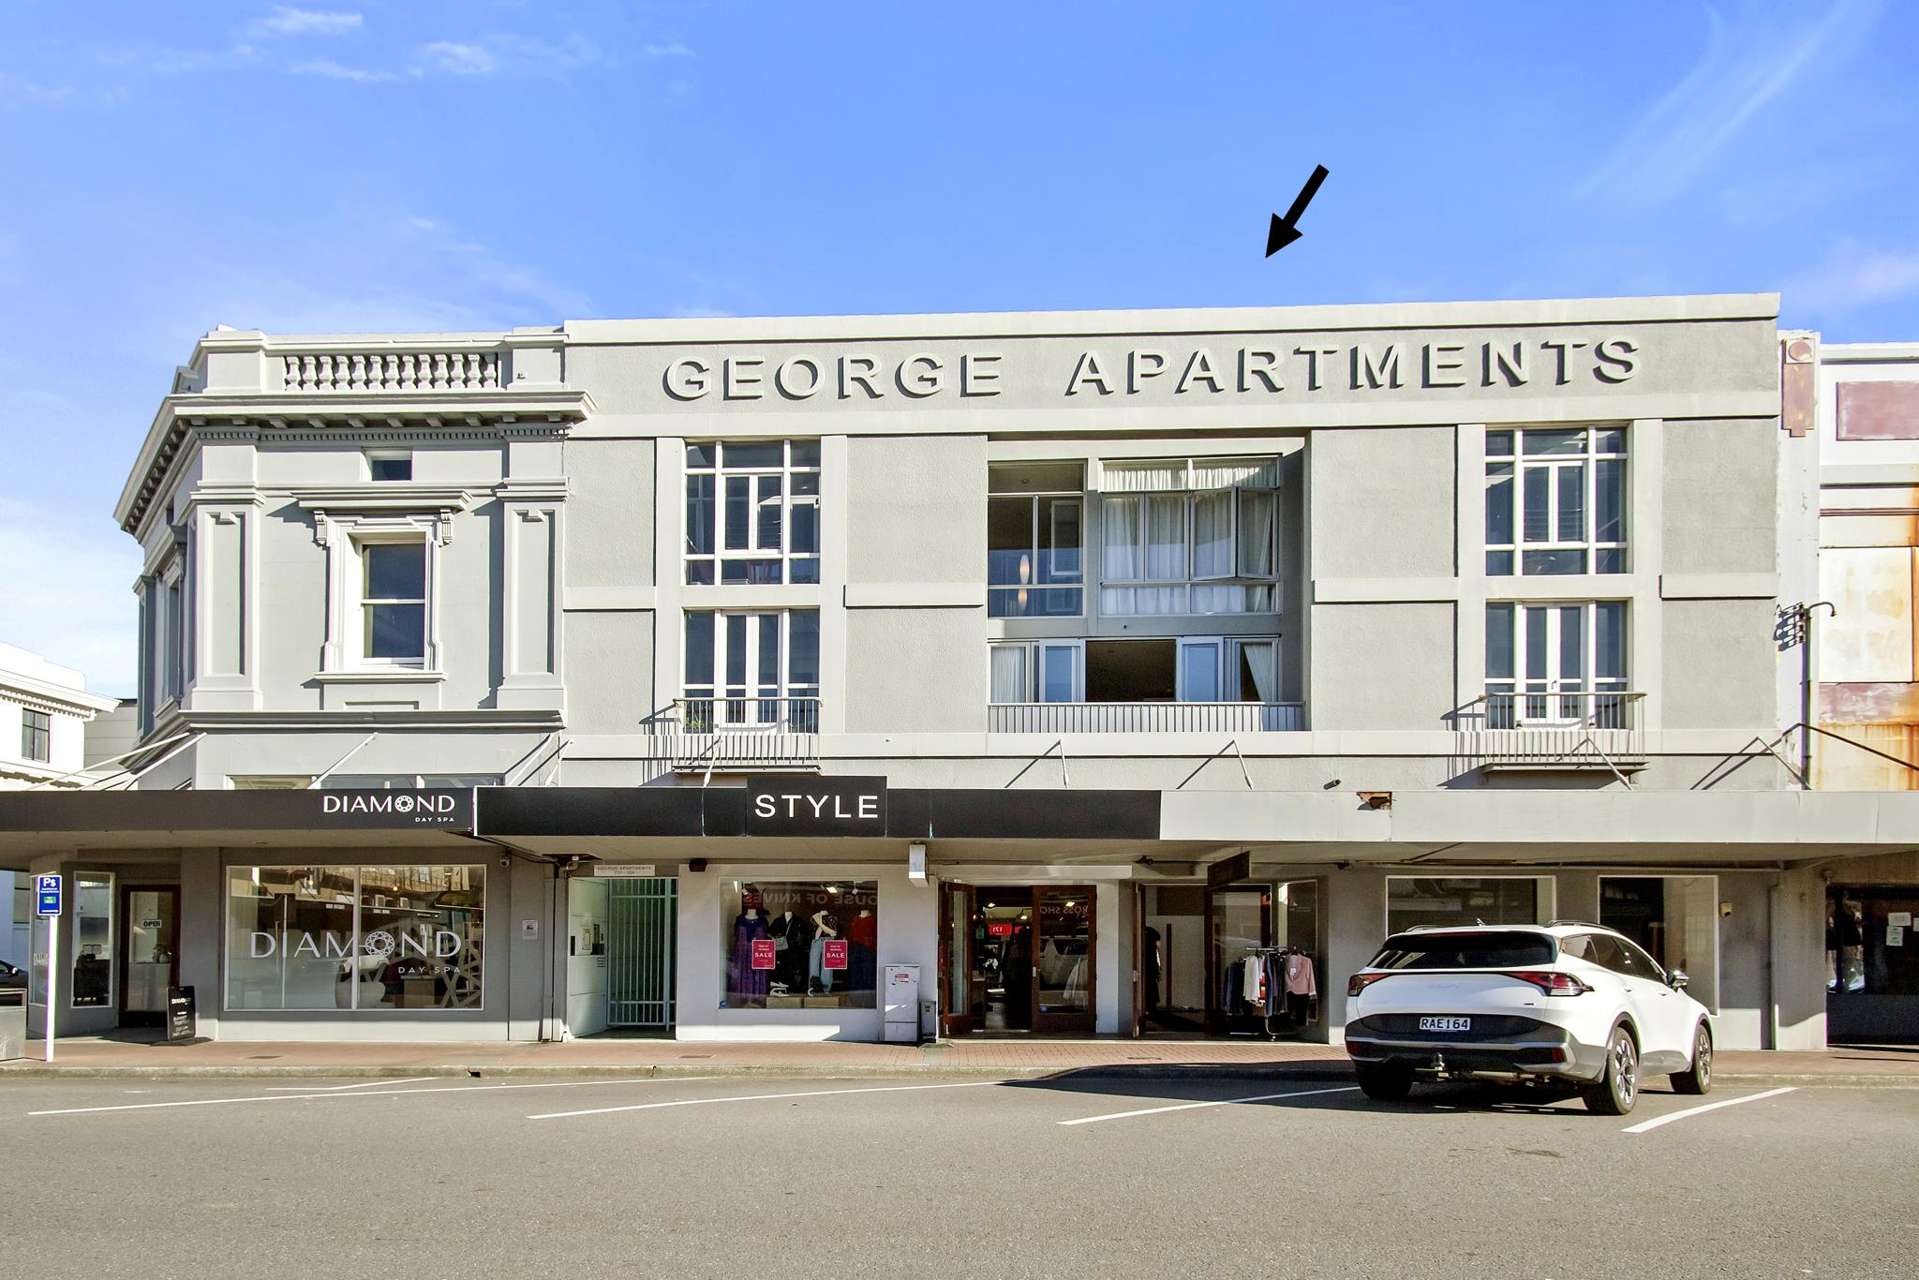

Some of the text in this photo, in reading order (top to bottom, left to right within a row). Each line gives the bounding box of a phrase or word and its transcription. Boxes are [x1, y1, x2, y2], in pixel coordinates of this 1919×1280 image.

[663, 335, 1640, 401] GEORGE APARTMENTS
[323, 795, 456, 813] DIAMOND
[754, 794, 879, 818] STYLE
[398, 966, 461, 974] DAY SPA
[1421, 1018, 1468, 1030] RAE164
